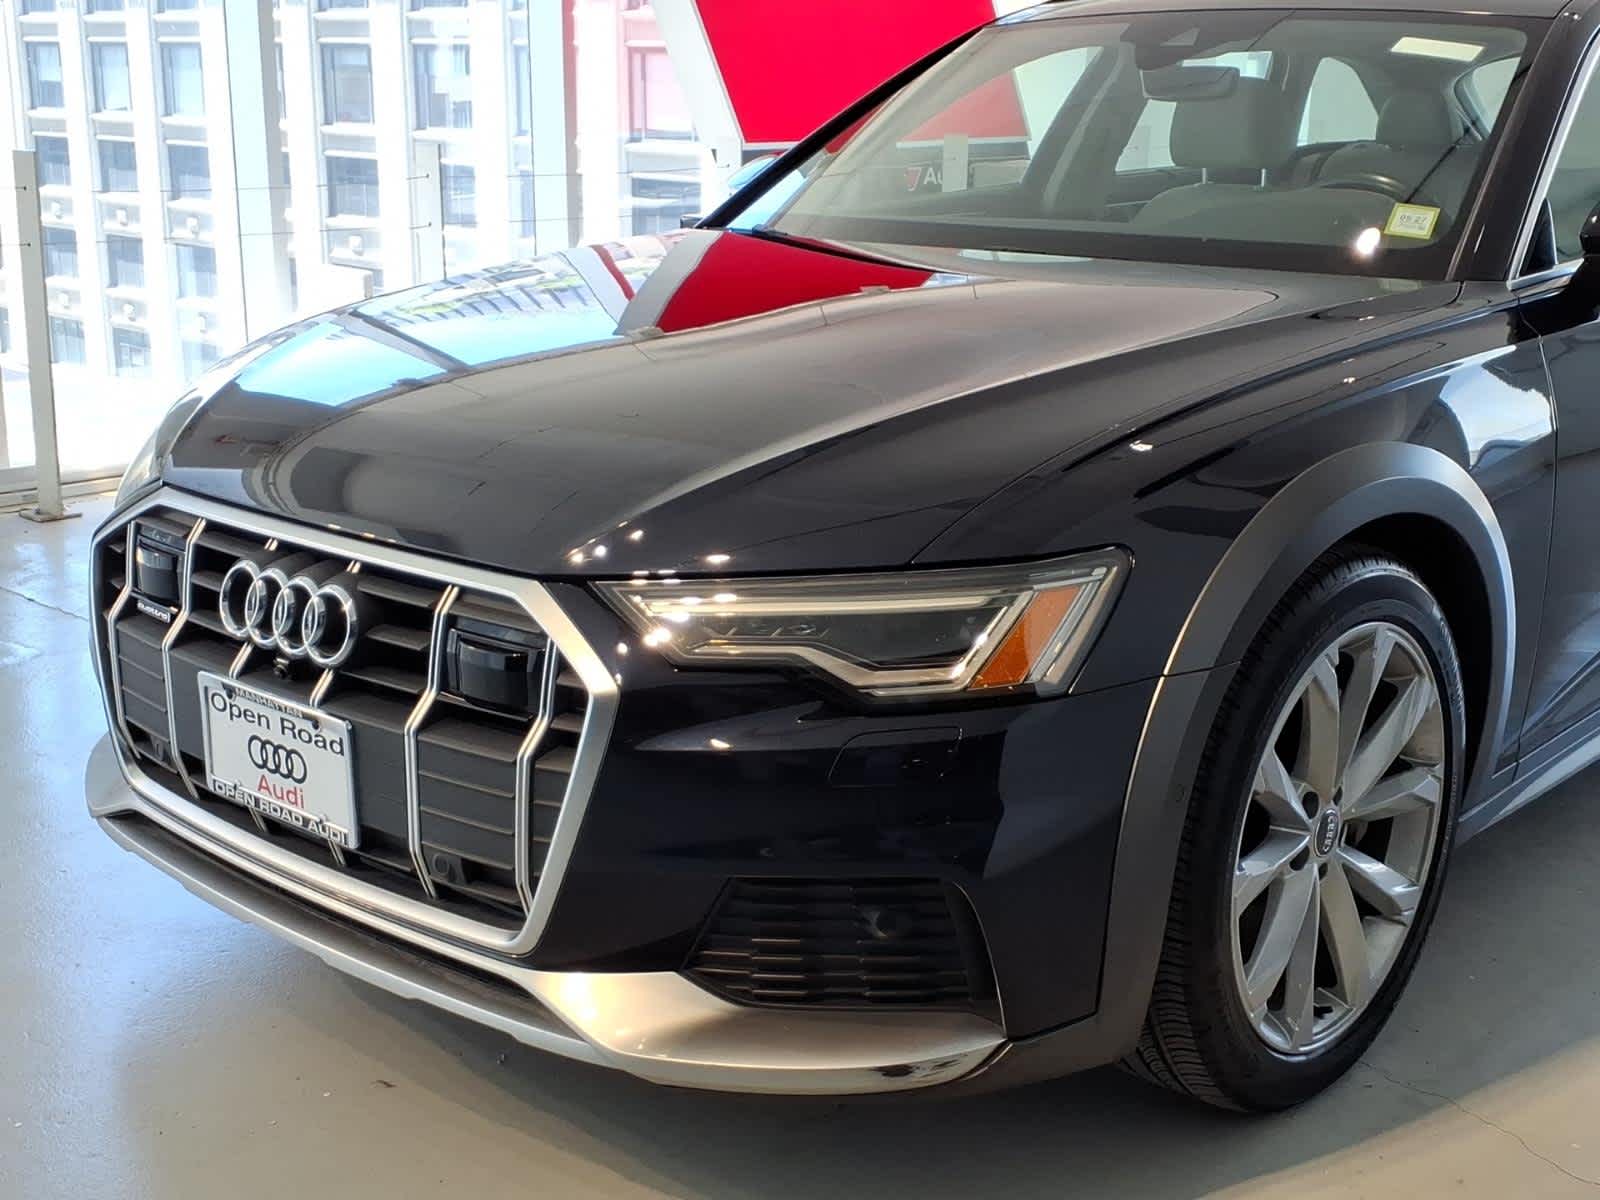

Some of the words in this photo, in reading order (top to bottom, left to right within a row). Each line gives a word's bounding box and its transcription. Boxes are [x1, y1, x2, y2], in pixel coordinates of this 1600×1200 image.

[210, 692, 271, 730] Open
[280, 717, 345, 756] Road
[235, 688, 304, 718] MANHATTAN
[215, 779, 255, 808] OPEN
[259, 801, 303, 826] ROAD
[307, 822, 347, 847] AUDI
[258, 774, 305, 809] Audi
